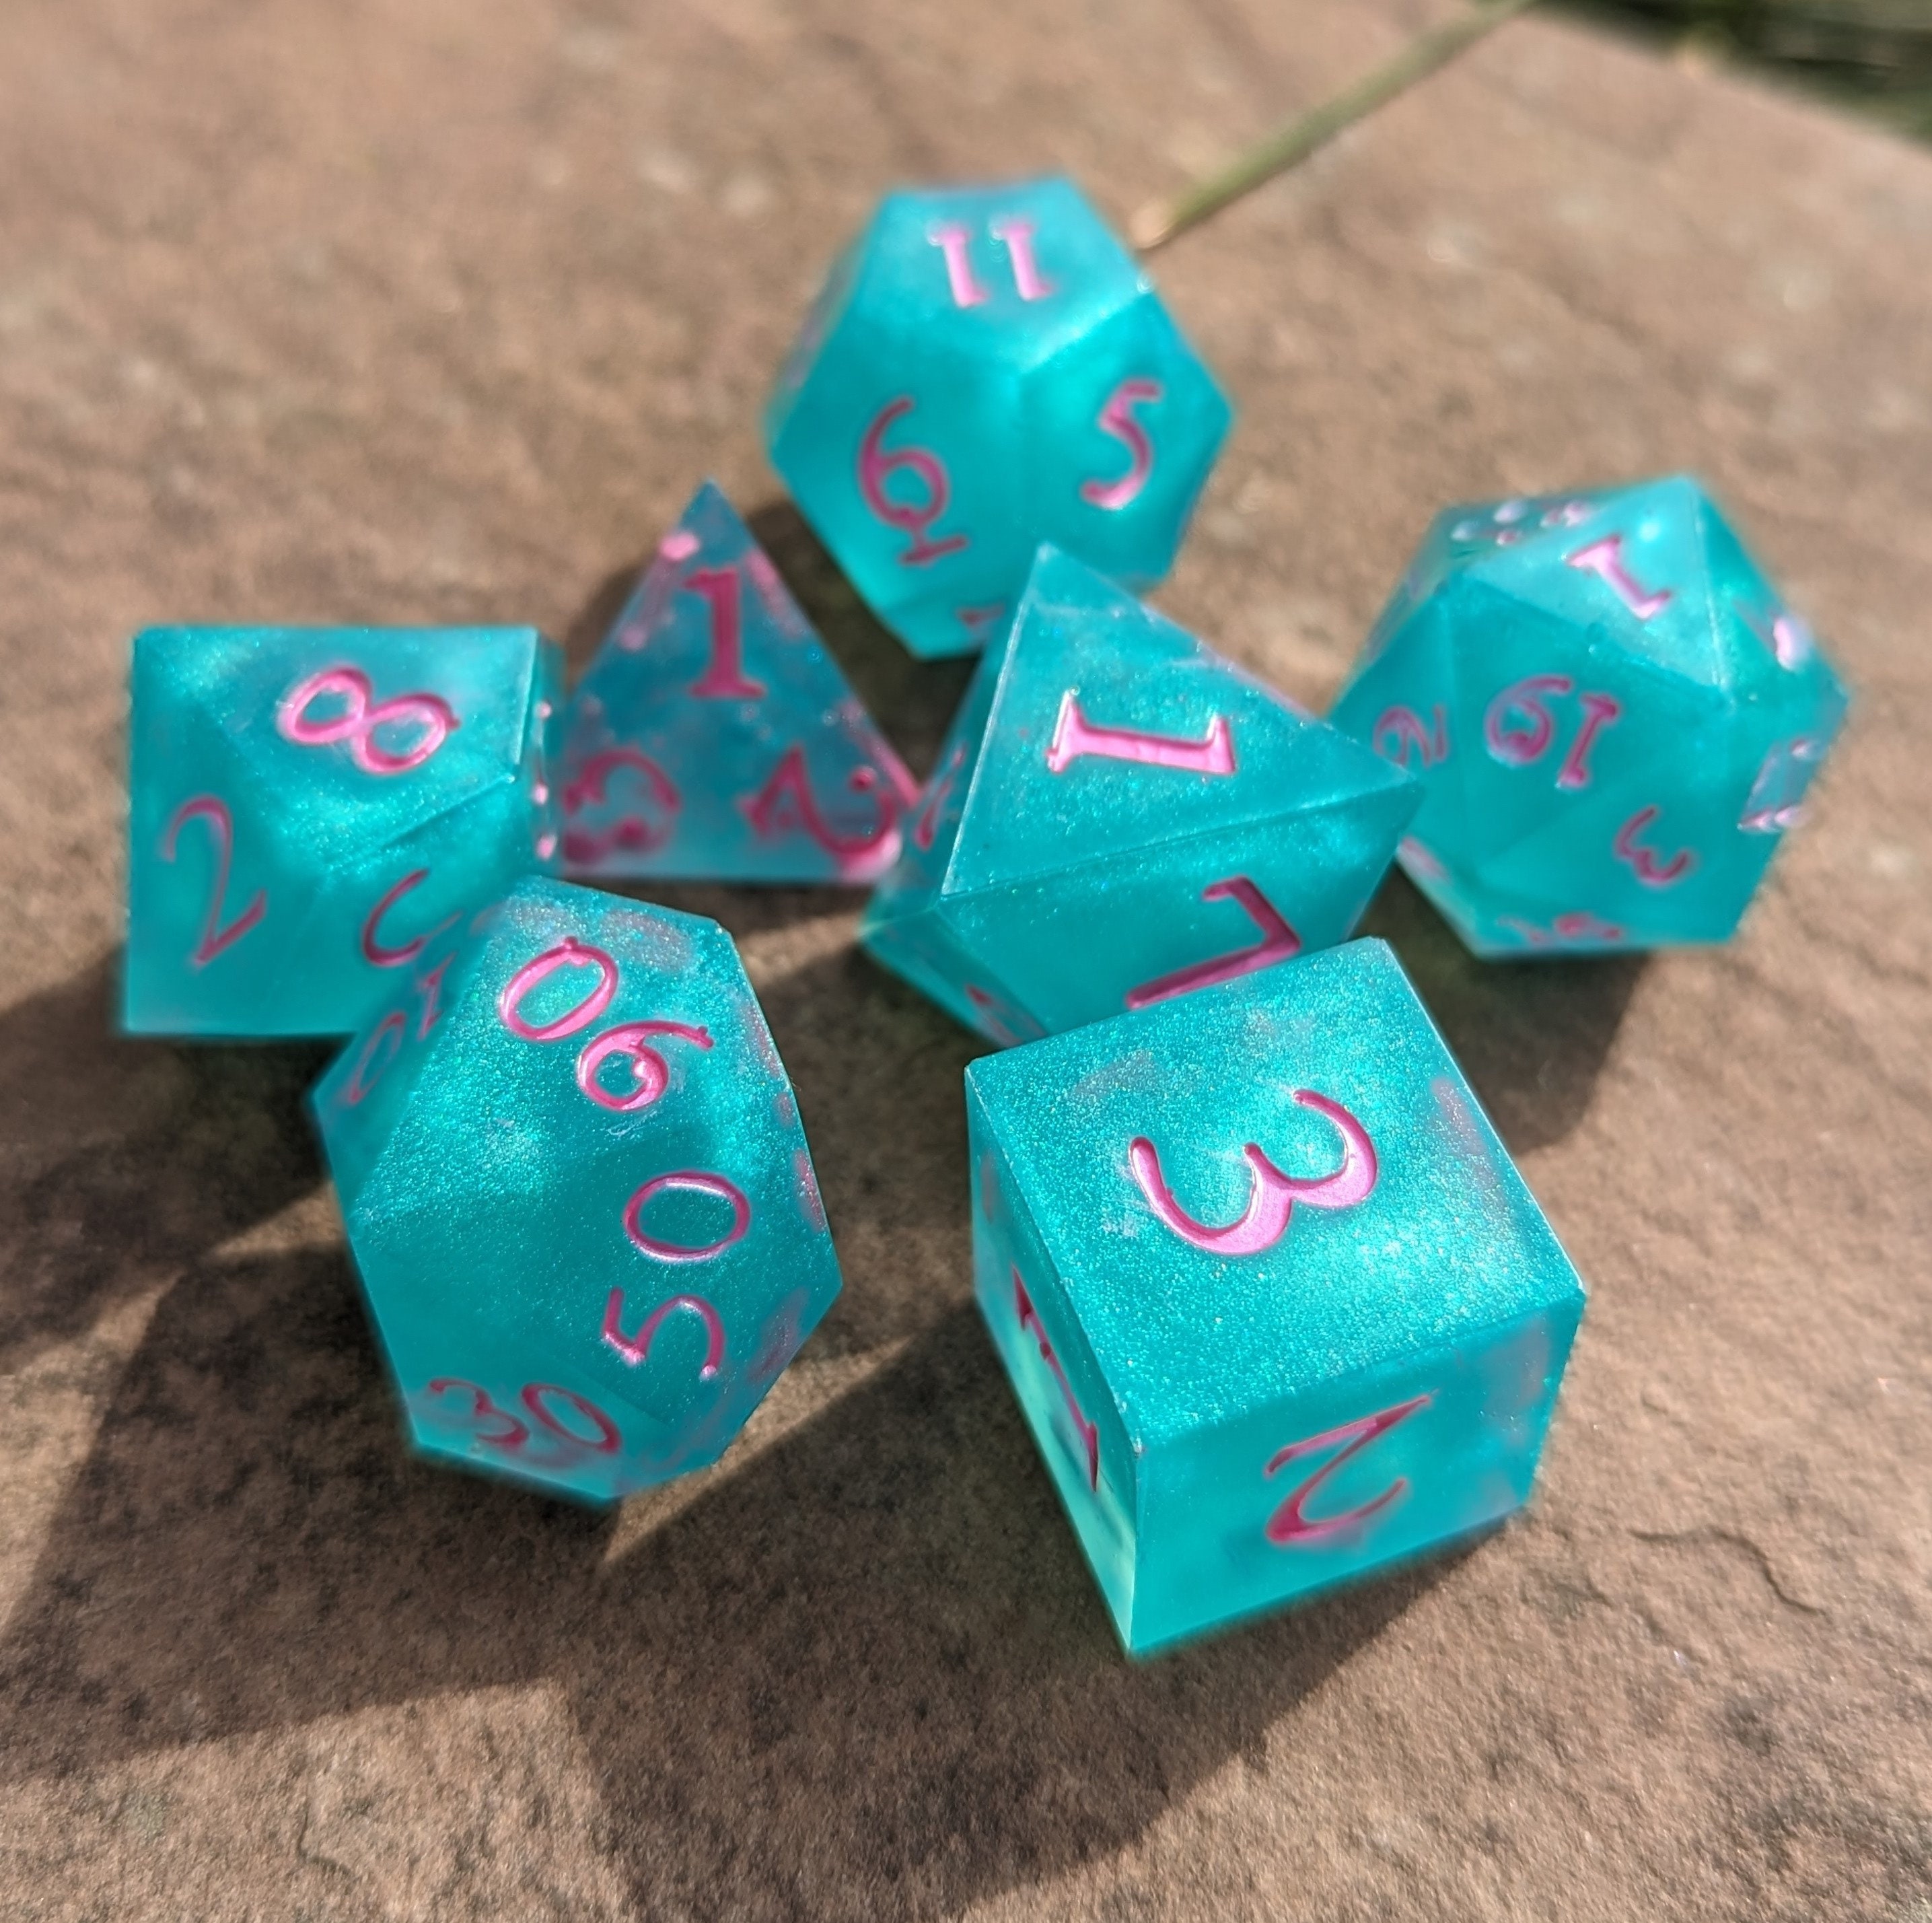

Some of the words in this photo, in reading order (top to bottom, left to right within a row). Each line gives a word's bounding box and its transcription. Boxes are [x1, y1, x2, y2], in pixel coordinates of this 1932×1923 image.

[927, 221, 1060, 310] 11
[1078, 377, 1164, 510] 5
[682, 565, 767, 700] 1
[1567, 534, 1674, 621] 1
[275, 662, 461, 775] 8
[1046, 688, 1236, 775] 1
[160, 793, 267, 969] 2
[1614, 806, 1694, 890] 3
[1129, 1089, 1380, 1257] 3
[428, 1377, 623, 1455] 30
[1265, 1391, 1433, 1544] 2
